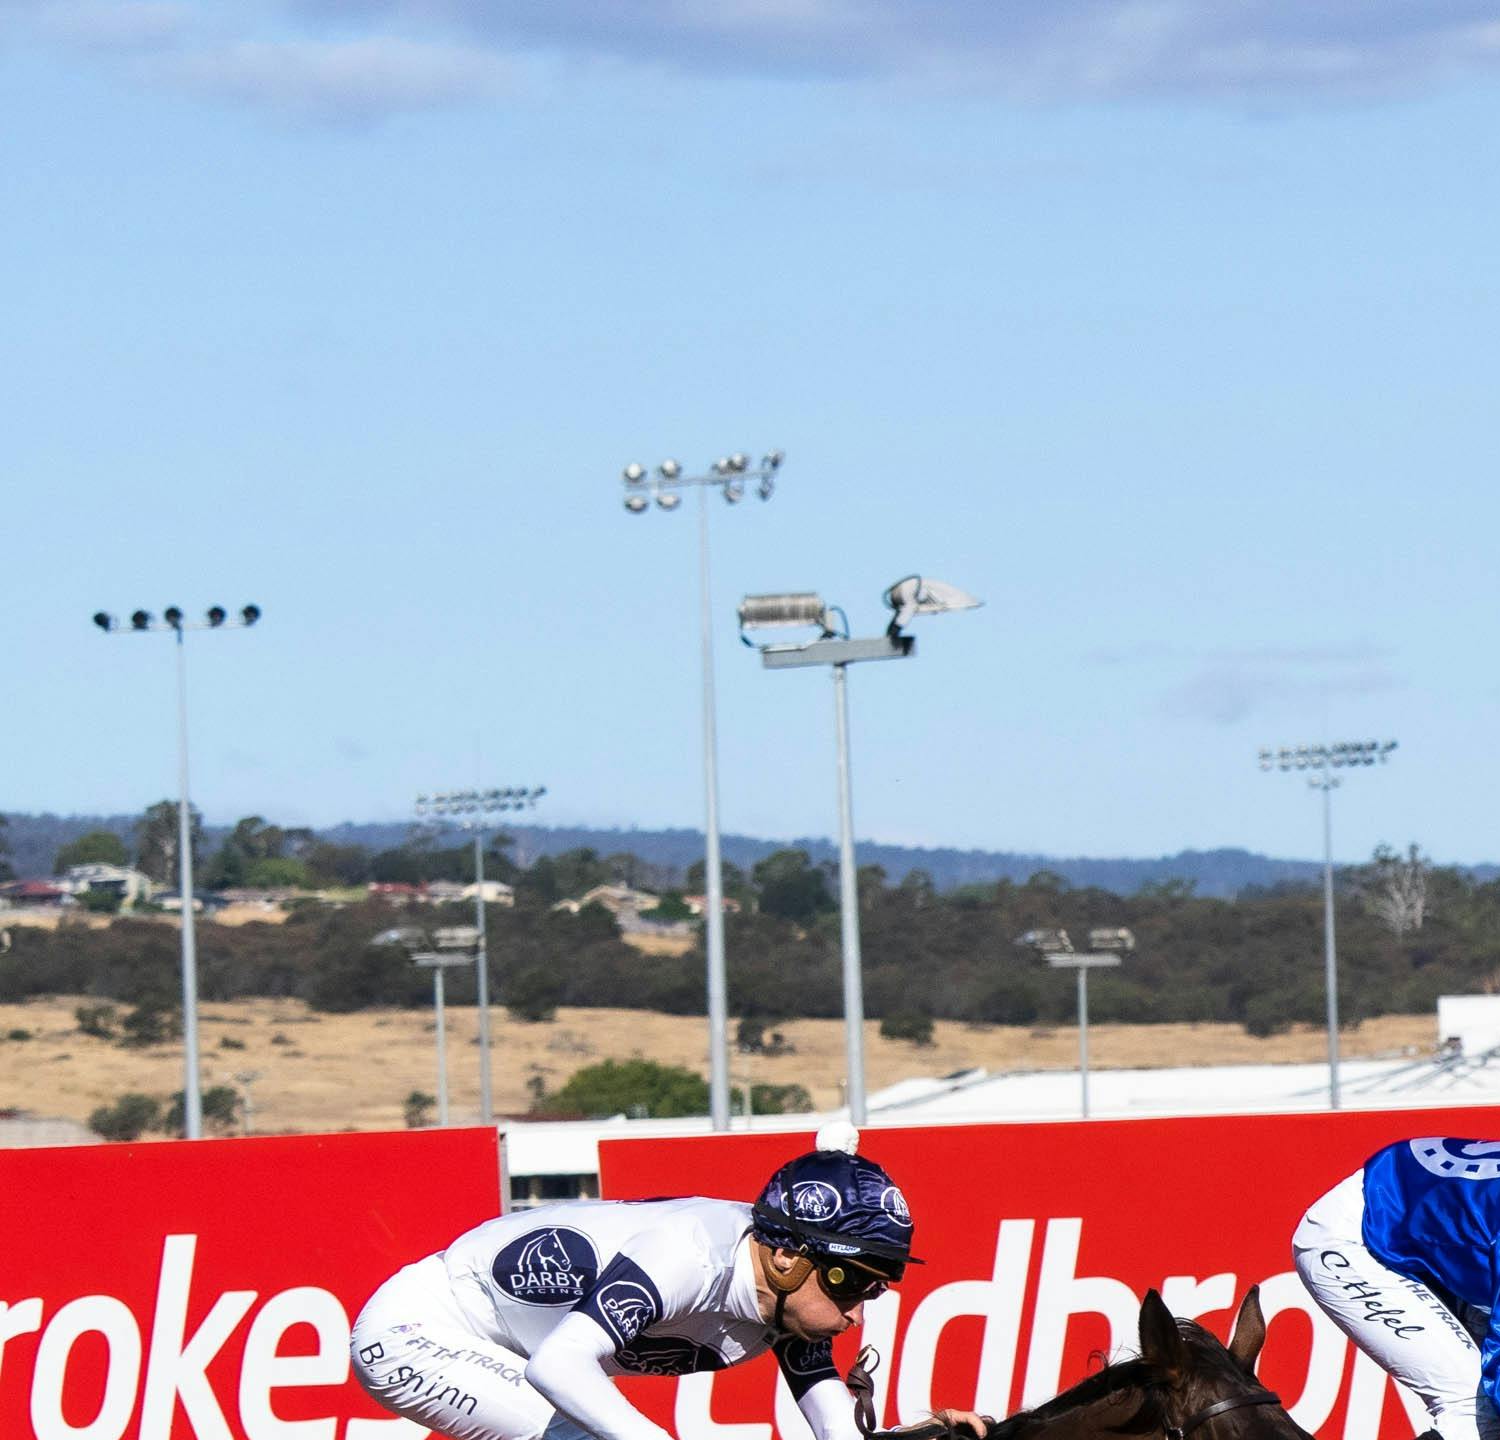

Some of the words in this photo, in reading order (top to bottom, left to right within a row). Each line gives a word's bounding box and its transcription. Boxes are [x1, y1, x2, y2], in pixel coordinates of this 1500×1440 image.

[795, 1201, 831, 1214] ARBY
[509, 1271, 585, 1289] DARBY
[513, 1288, 585, 1297] RACING
[605, 1297, 637, 1340] DARB
[1429, 1302, 1478, 1351] TRACK
[465, 1351, 526, 1387] TRACK
[388, 1365, 479, 1416] Shinn
